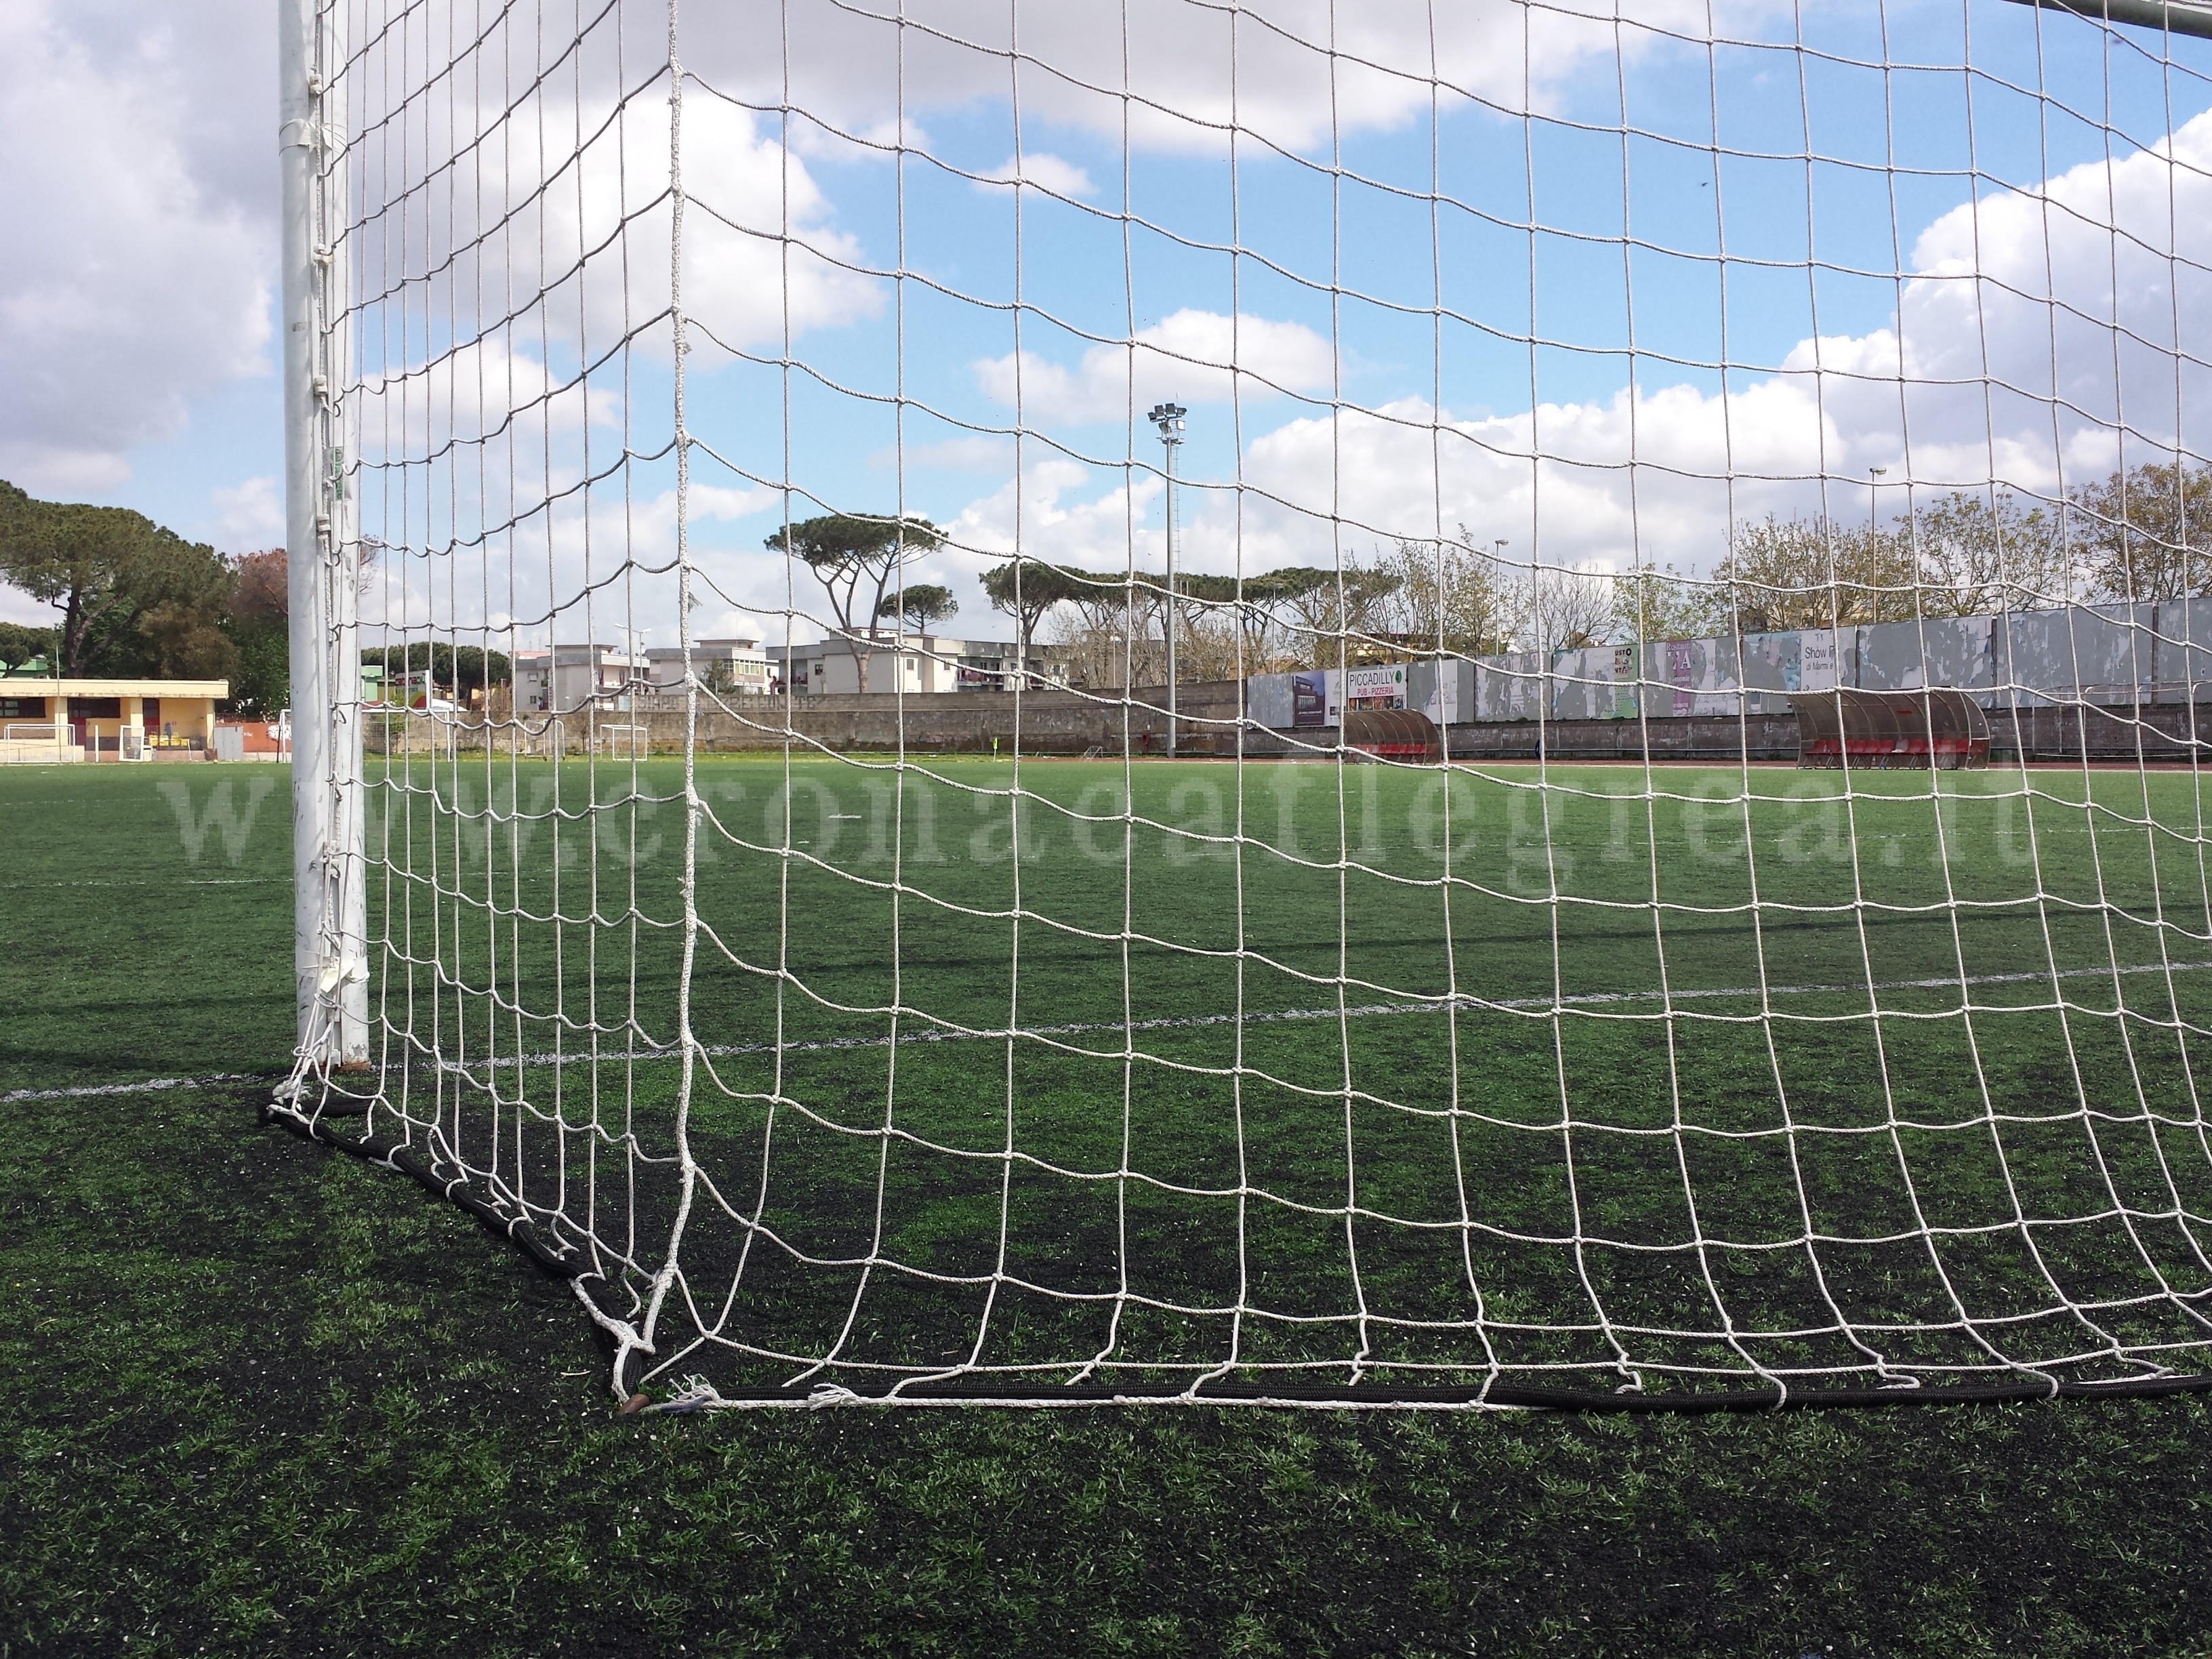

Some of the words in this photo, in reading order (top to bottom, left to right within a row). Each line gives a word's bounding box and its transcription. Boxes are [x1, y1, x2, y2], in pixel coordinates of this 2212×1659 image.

[1805, 646, 1826, 659] Show
[1349, 671, 1395, 687] PICCADILLY
[1357, 688, 1368, 696] PUB
[1371, 686, 1394, 696] PIZZERIA
